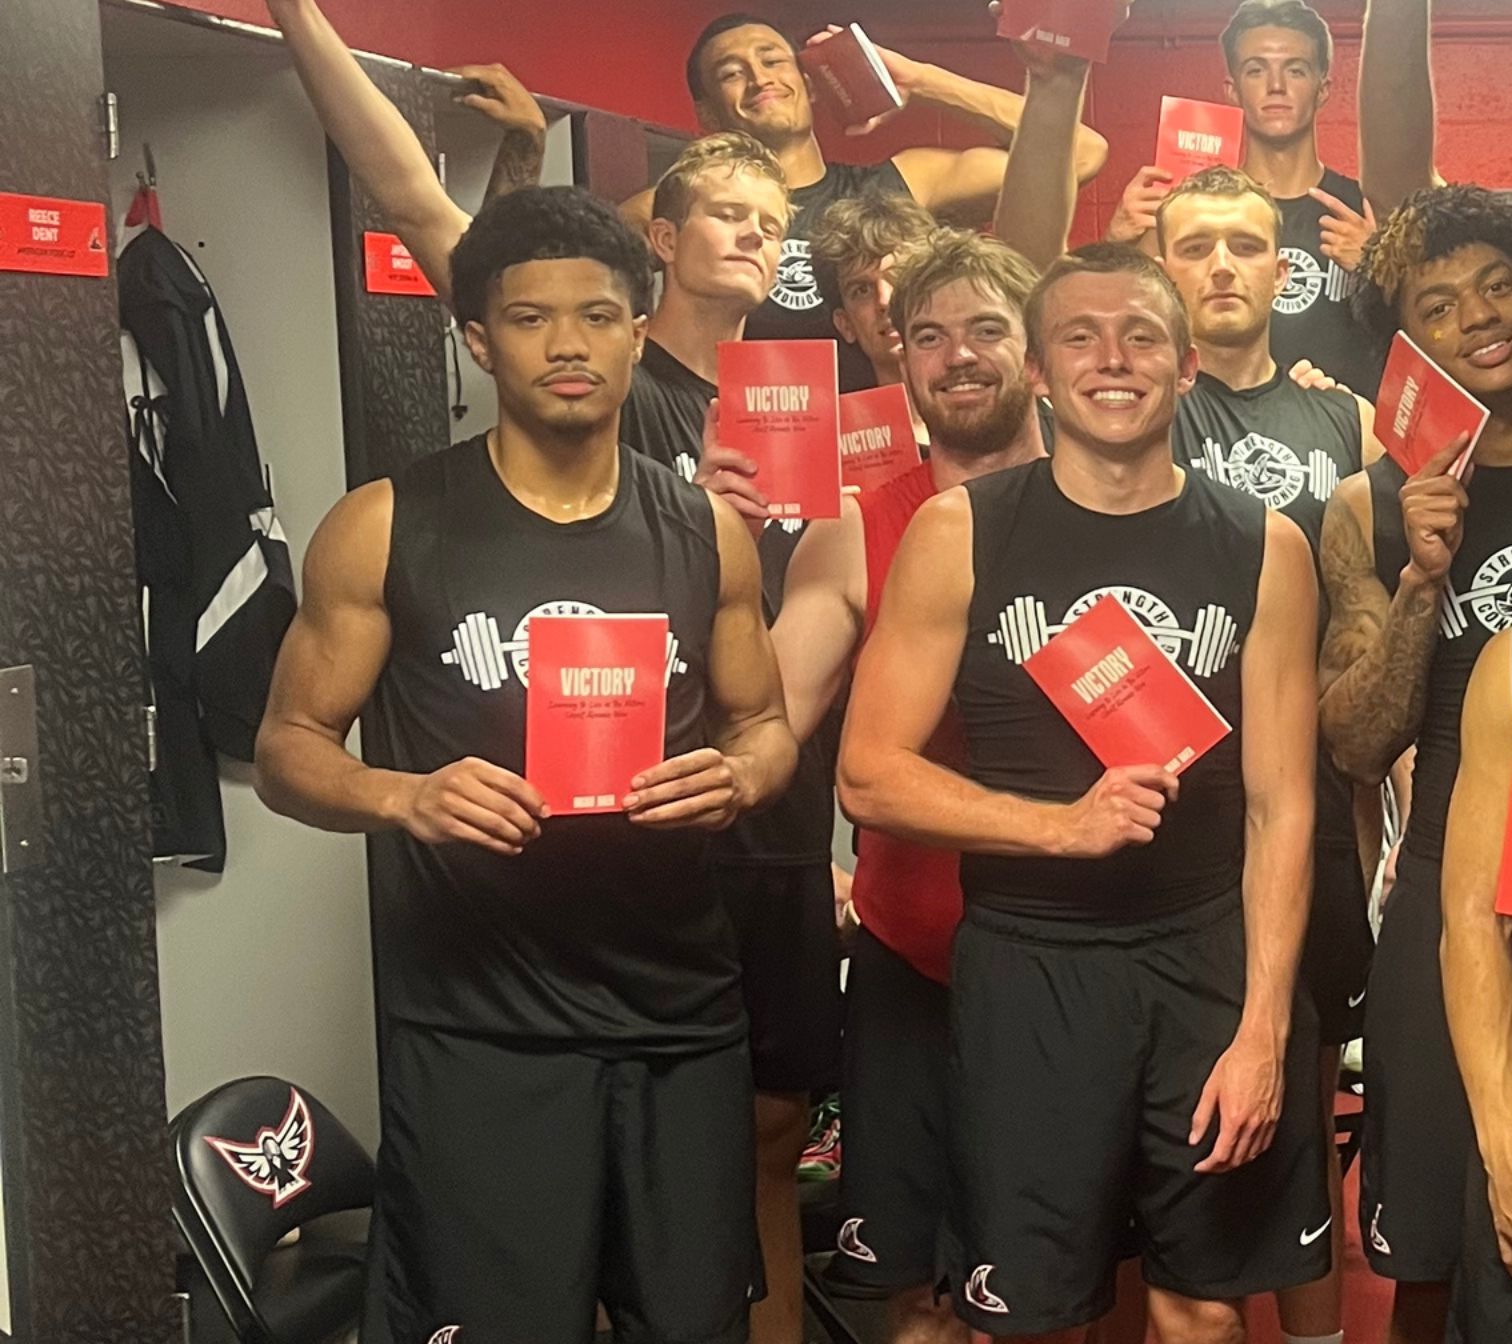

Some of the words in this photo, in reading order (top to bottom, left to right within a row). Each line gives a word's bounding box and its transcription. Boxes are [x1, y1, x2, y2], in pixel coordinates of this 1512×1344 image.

[1178, 130, 1222, 155] VICTORY
[745, 384, 809, 412] VICTORY
[1393, 375, 1420, 439] VICTORY
[839, 425, 892, 456] VICTORY
[561, 667, 635, 696] VICTORY
[1070, 645, 1135, 705] VICTORY
